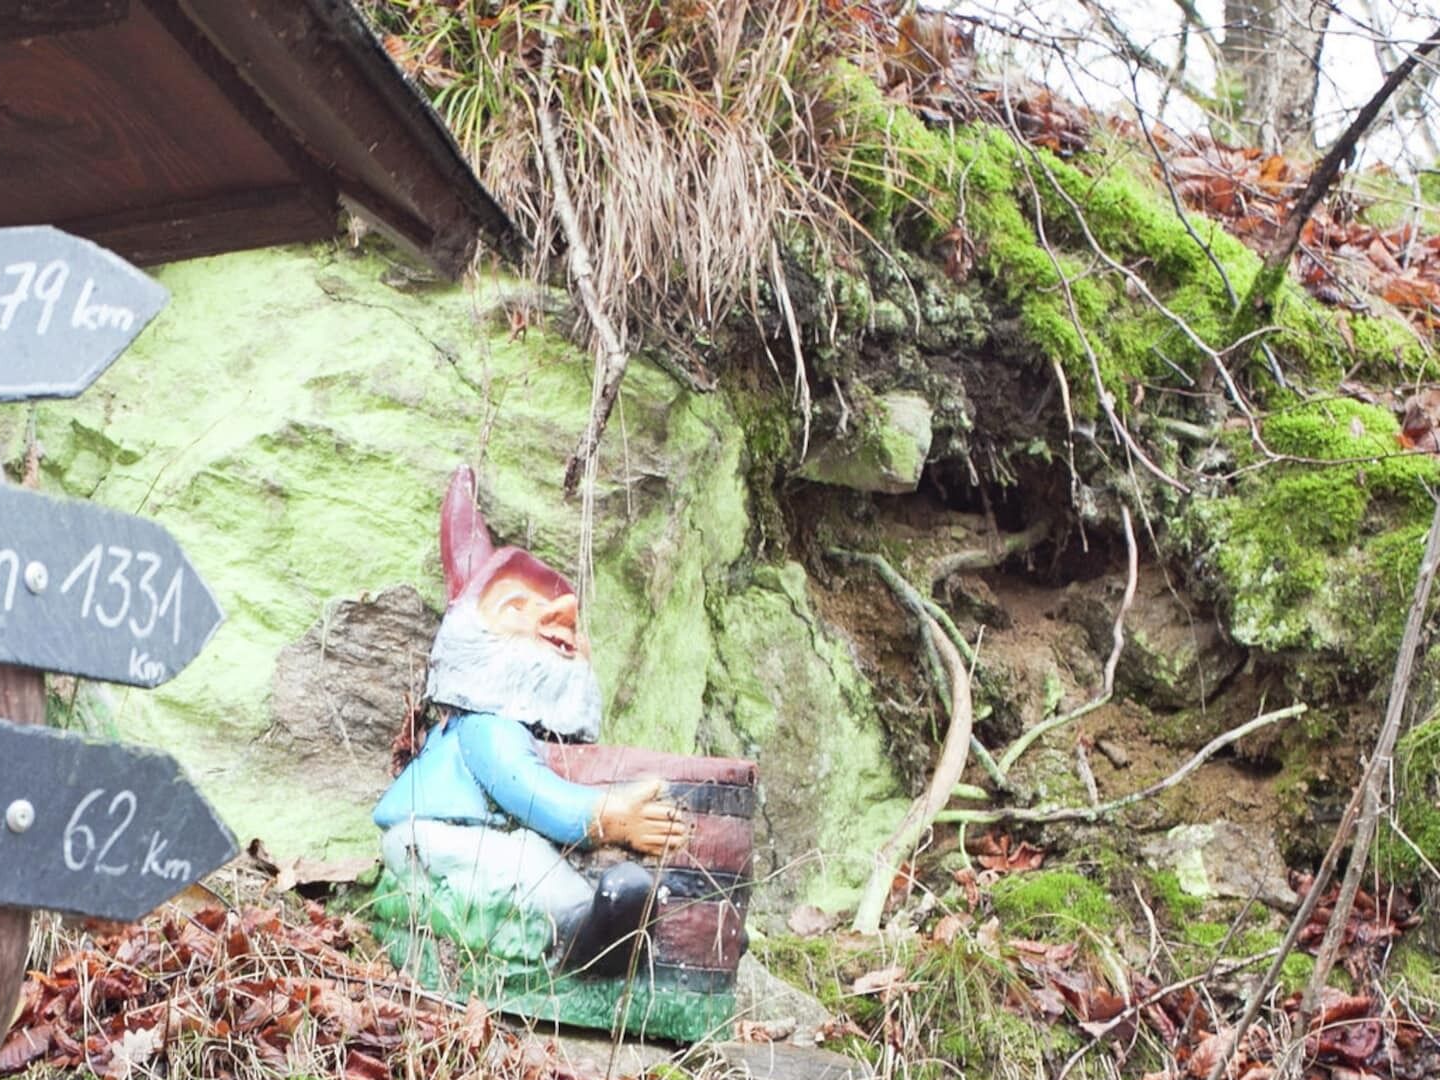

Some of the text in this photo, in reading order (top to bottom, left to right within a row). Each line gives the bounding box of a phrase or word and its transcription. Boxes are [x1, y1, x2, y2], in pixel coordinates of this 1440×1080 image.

[71, 280, 136, 333] km
[60, 544, 182, 644] 1331
[63, 788, 138, 876] 62
